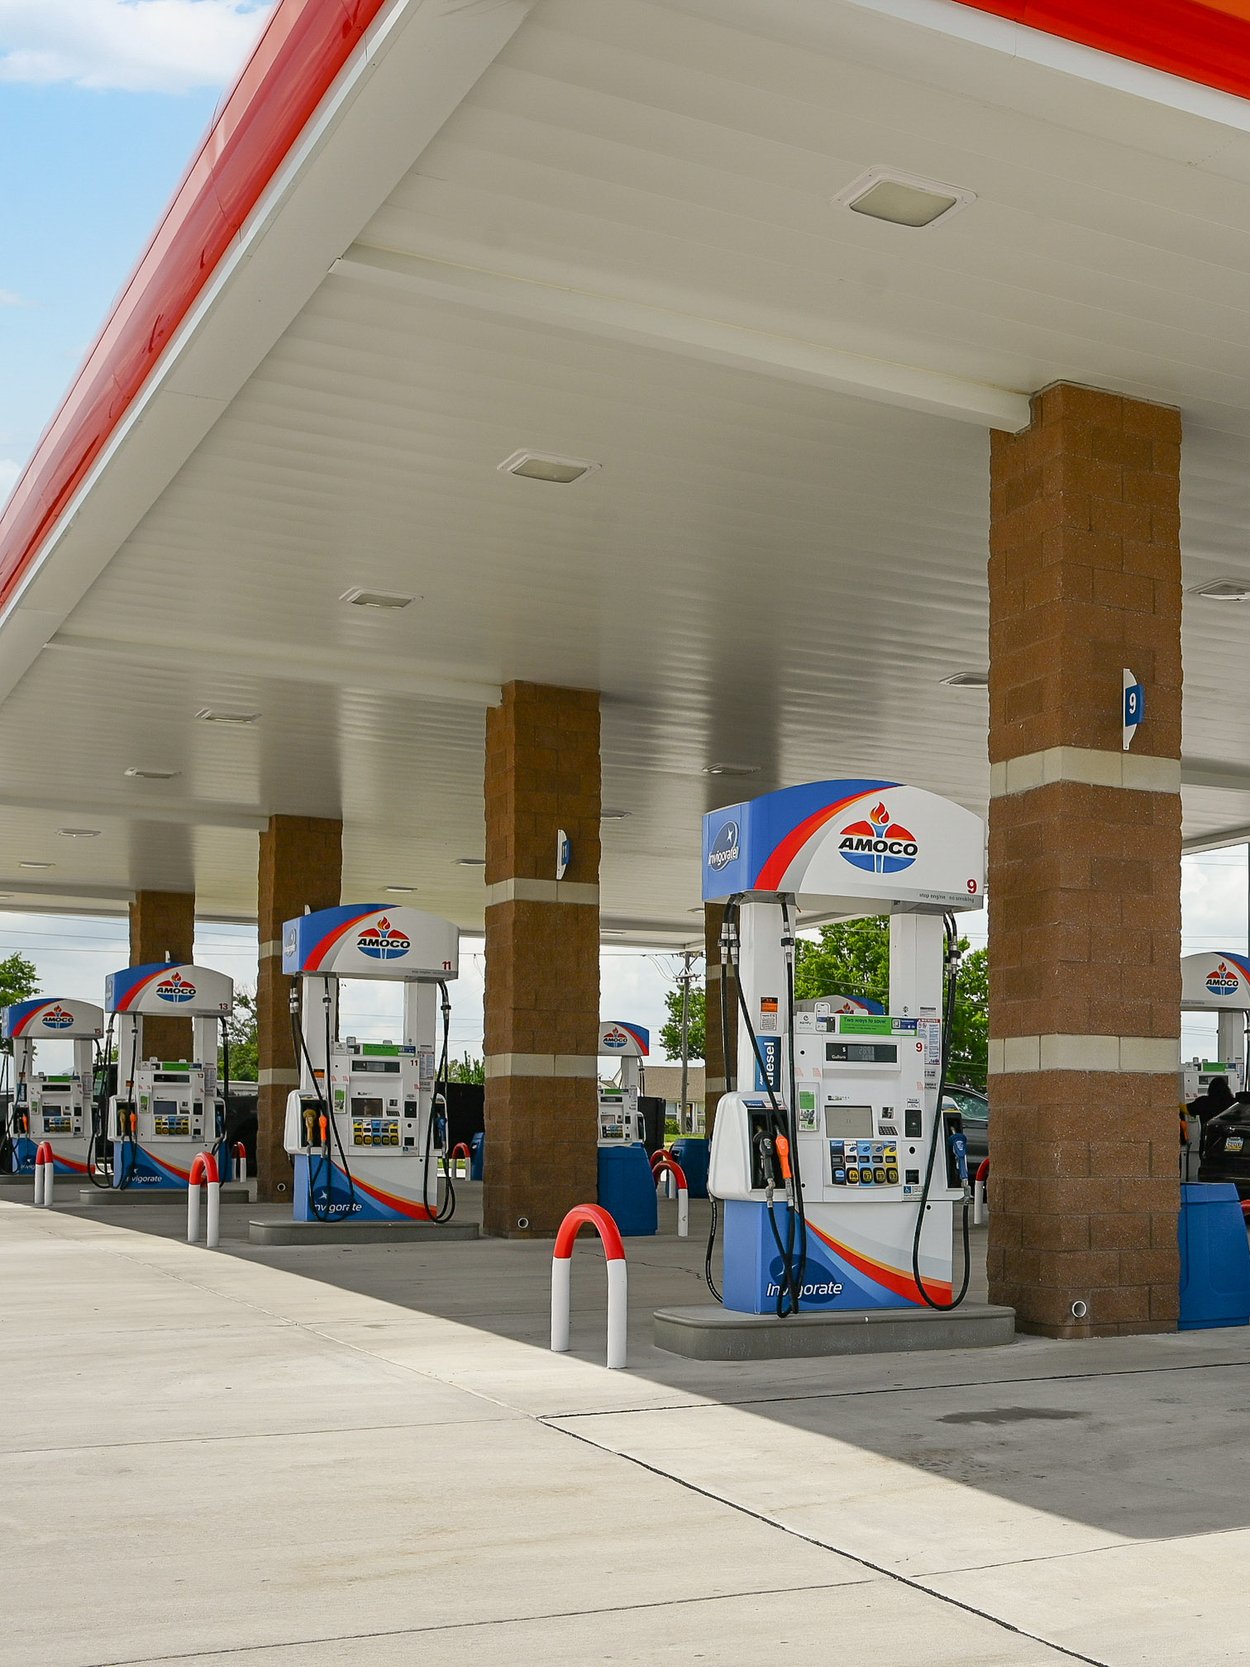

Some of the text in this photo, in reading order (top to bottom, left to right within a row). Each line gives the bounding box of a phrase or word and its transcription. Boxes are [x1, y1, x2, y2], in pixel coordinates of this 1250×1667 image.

[1129, 692, 1137, 715] 9
[838, 837, 918, 856] AMOCO
[966, 878, 978, 895] 9
[357, 938, 411, 949] AMOCO
[441, 961, 452, 970] 11
[1205, 979, 1239, 987] AMOCO
[156, 987, 197, 995] AMOCO
[219, 1002, 229, 1010] 13
[915, 1041, 923, 1053] 9
[127, 1175, 162, 1184] vigorate
[313, 1202, 363, 1214] nvgorte
[766, 1281, 843, 1299] Inorate
